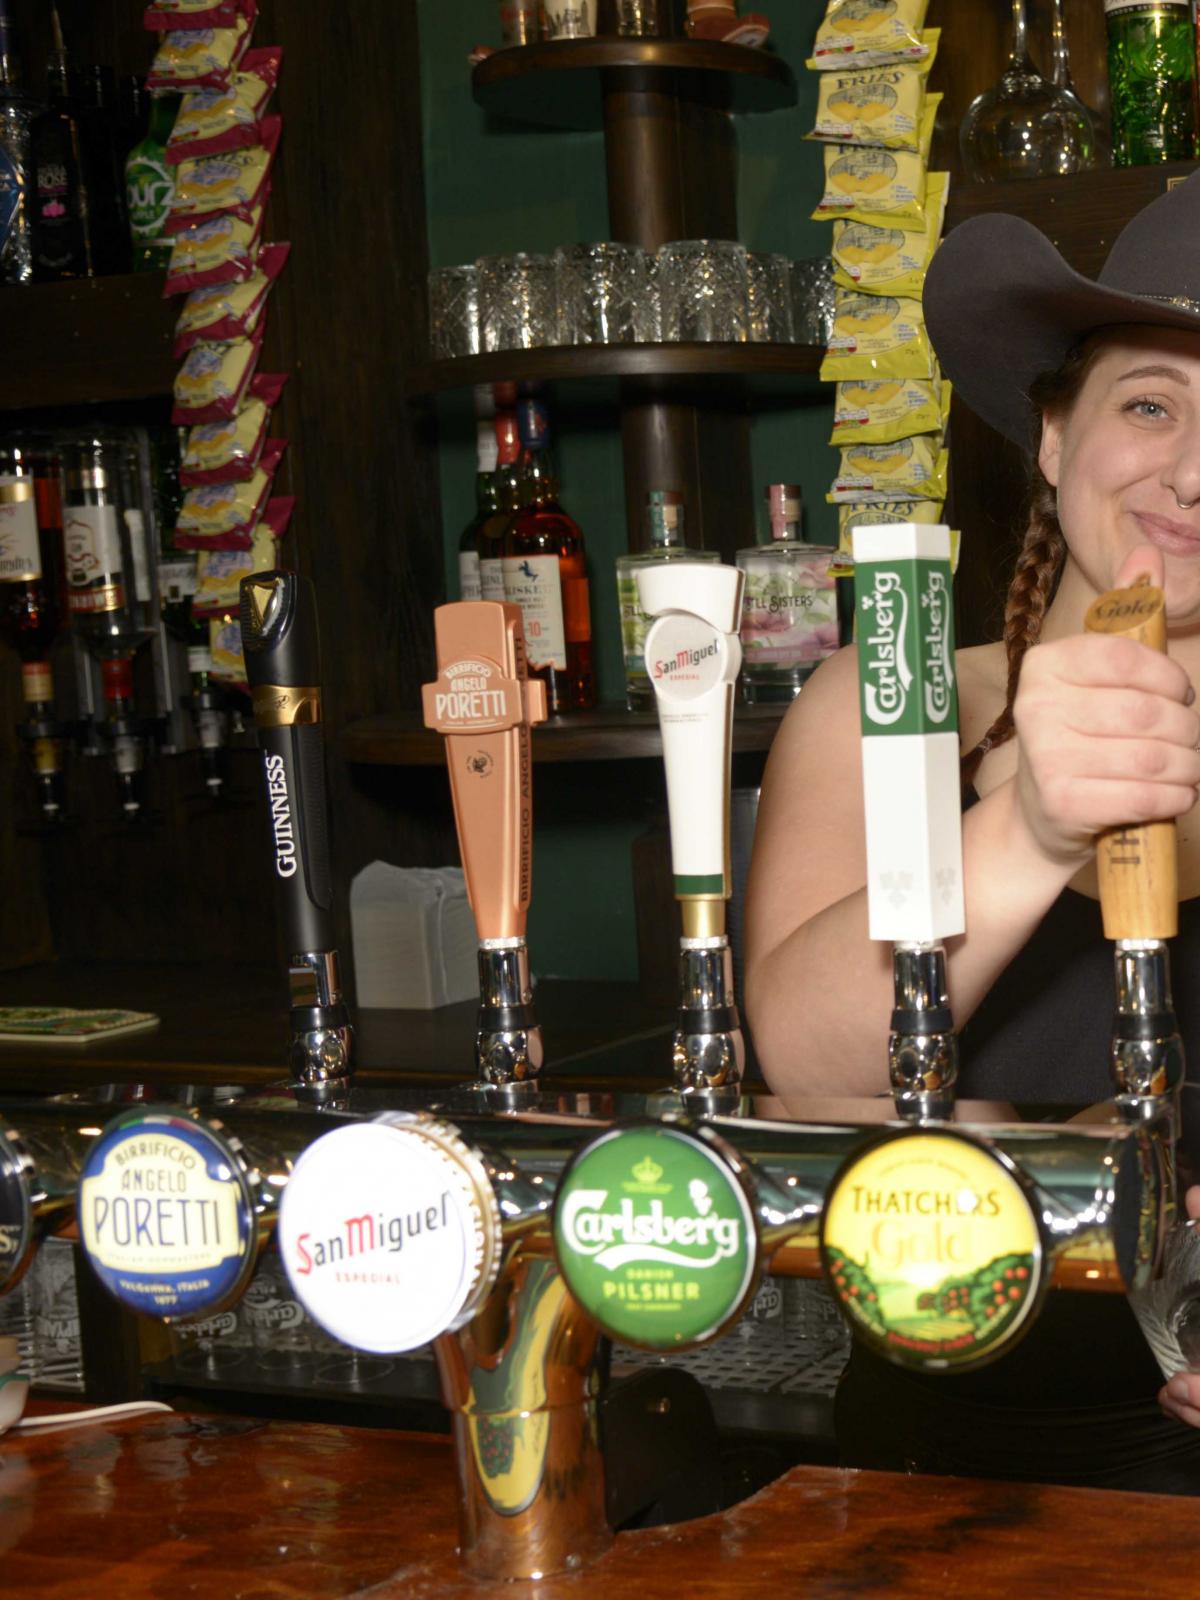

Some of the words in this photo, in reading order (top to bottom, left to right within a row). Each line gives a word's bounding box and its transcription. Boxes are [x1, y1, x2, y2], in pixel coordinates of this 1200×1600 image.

[836, 71, 904, 89] FRIES
[769, 595, 813, 613] SISTERS
[527, 622, 542, 638] 10
[921, 570, 953, 724] Carlsberg
[655, 640, 718, 680] SanMiguel
[862, 571, 912, 726] Carlsberg
[450, 678, 488, 692] ANGELO
[434, 689, 507, 721] PORETTI
[520, 724, 531, 798] ANGELO
[265, 754, 298, 878] GUINNESS
[520, 808, 531, 901] BIRRIFICIO
[114, 1141, 197, 1170] BIRRIFICIO
[120, 1168, 188, 1194] ANGELO
[93, 1195, 221, 1247] PORETTI
[296, 1189, 451, 1276] SanMiguel
[560, 1180, 740, 1262] Carlsberg
[335, 1270, 401, 1286] ESPECIAL
[601, 1279, 701, 1301] PILSNER
